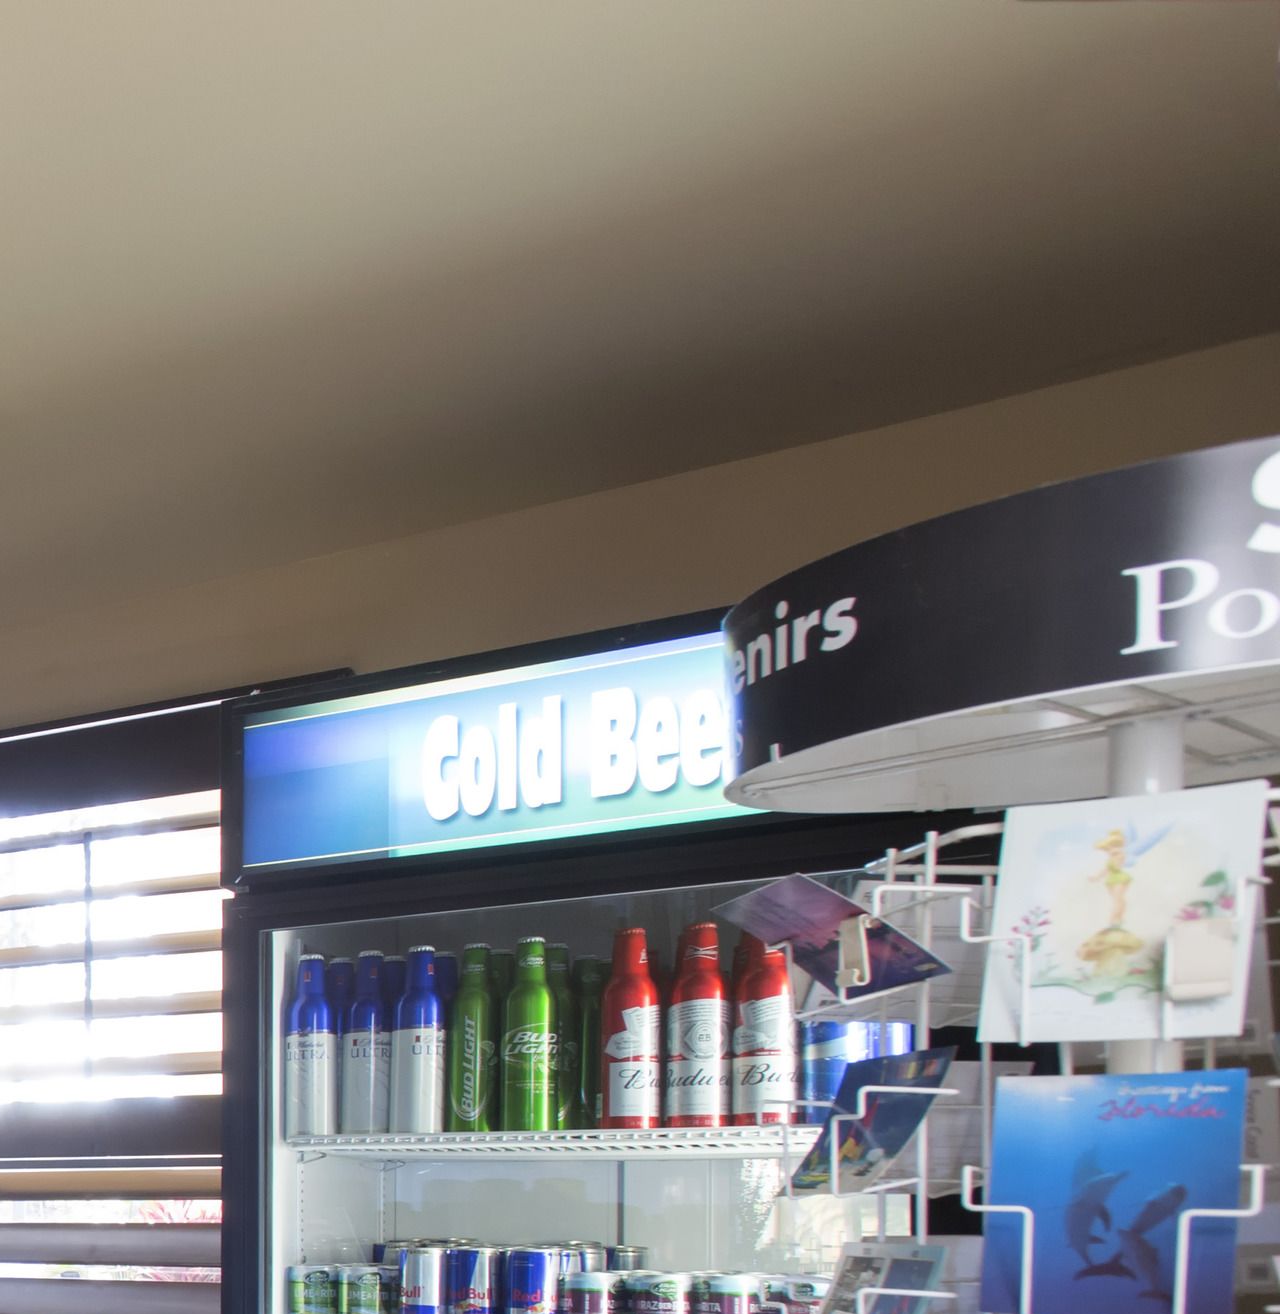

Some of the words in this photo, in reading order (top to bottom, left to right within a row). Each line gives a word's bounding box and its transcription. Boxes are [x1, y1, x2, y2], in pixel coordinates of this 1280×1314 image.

[421, 694, 563, 820] Cold
[591, 686, 731, 798] Bee
[464, 1016, 475, 1074] LIGHT
[506, 1043, 558, 1055] LIGHT
[514, 1031, 557, 1043] BUD
[351, 1047, 391, 1058] ULTR
[462, 1077, 474, 1113] BUD
